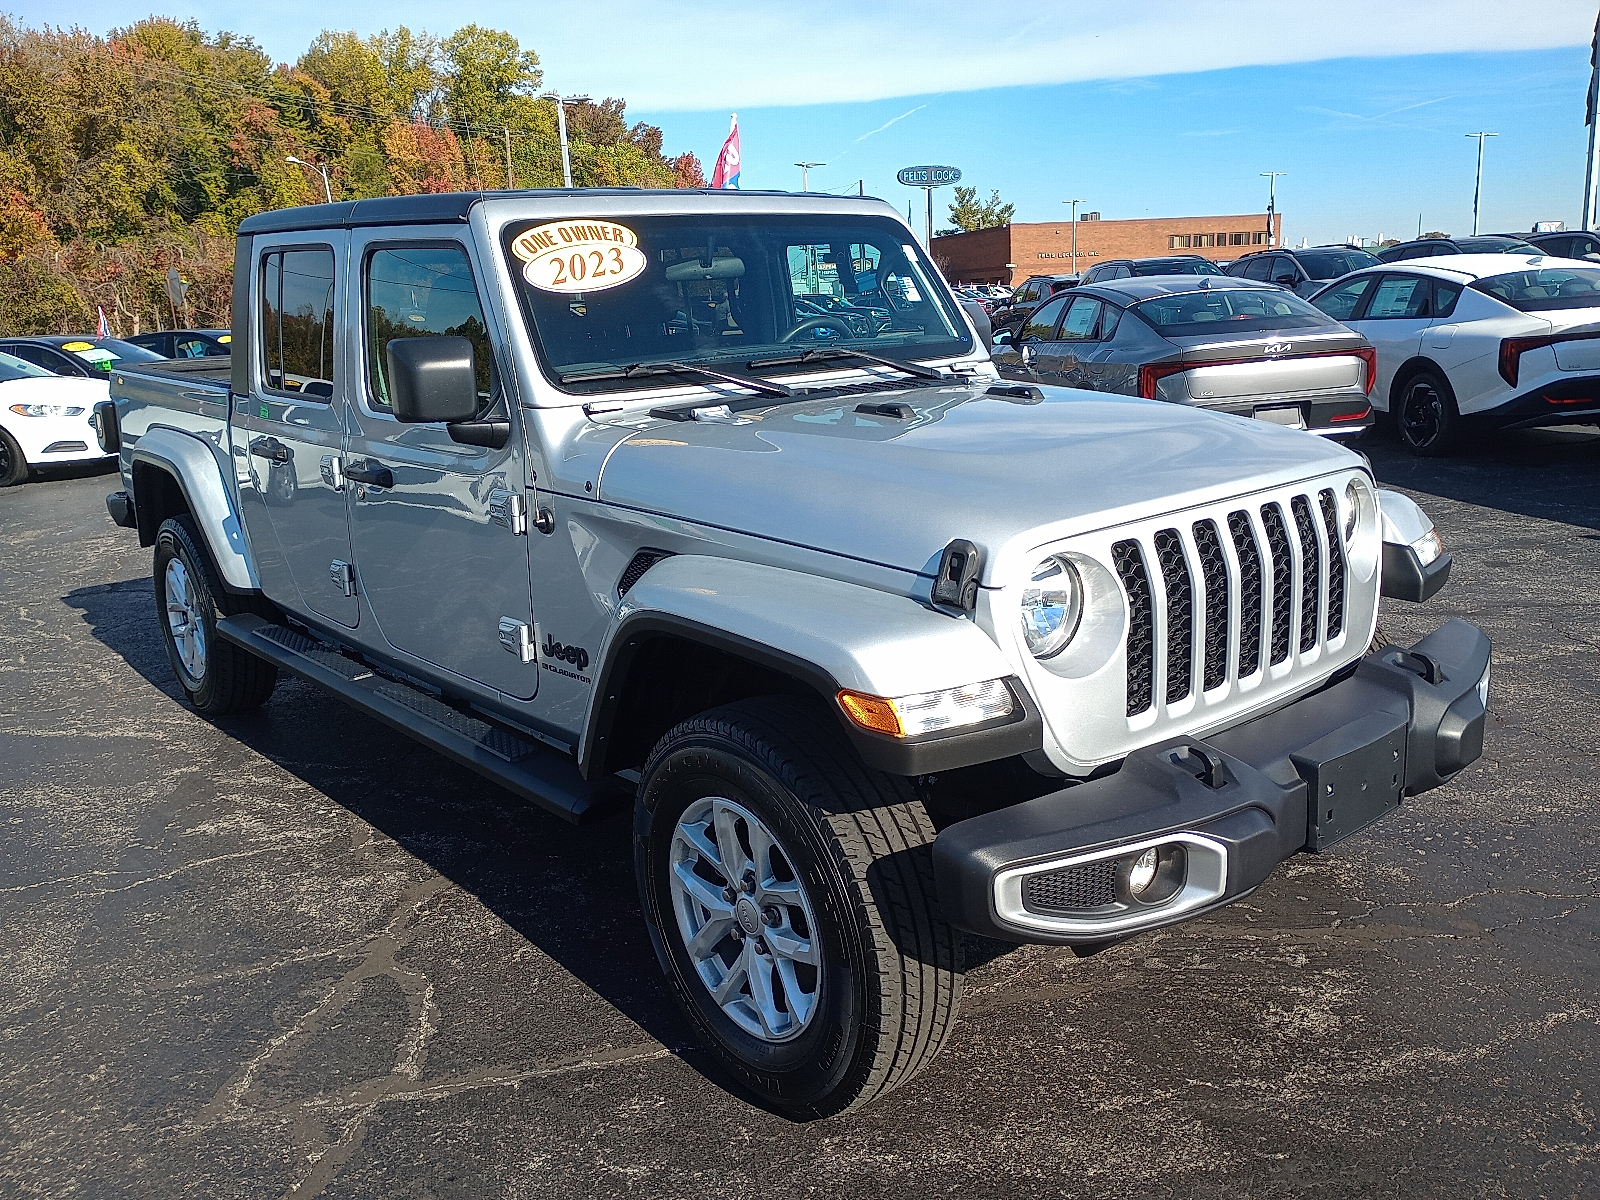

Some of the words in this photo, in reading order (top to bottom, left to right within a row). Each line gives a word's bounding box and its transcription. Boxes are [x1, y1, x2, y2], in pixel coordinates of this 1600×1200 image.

[903, 170, 928, 181] FELTS
[931, 170, 955, 181] LOCK
[520, 230, 558, 254] ONE
[558, 226, 624, 243] OWNER
[549, 248, 624, 285] 2023
[541, 632, 589, 671] Jeep
[549, 664, 592, 685] GLADIATOR
[741, 903, 753, 929] Jeep
